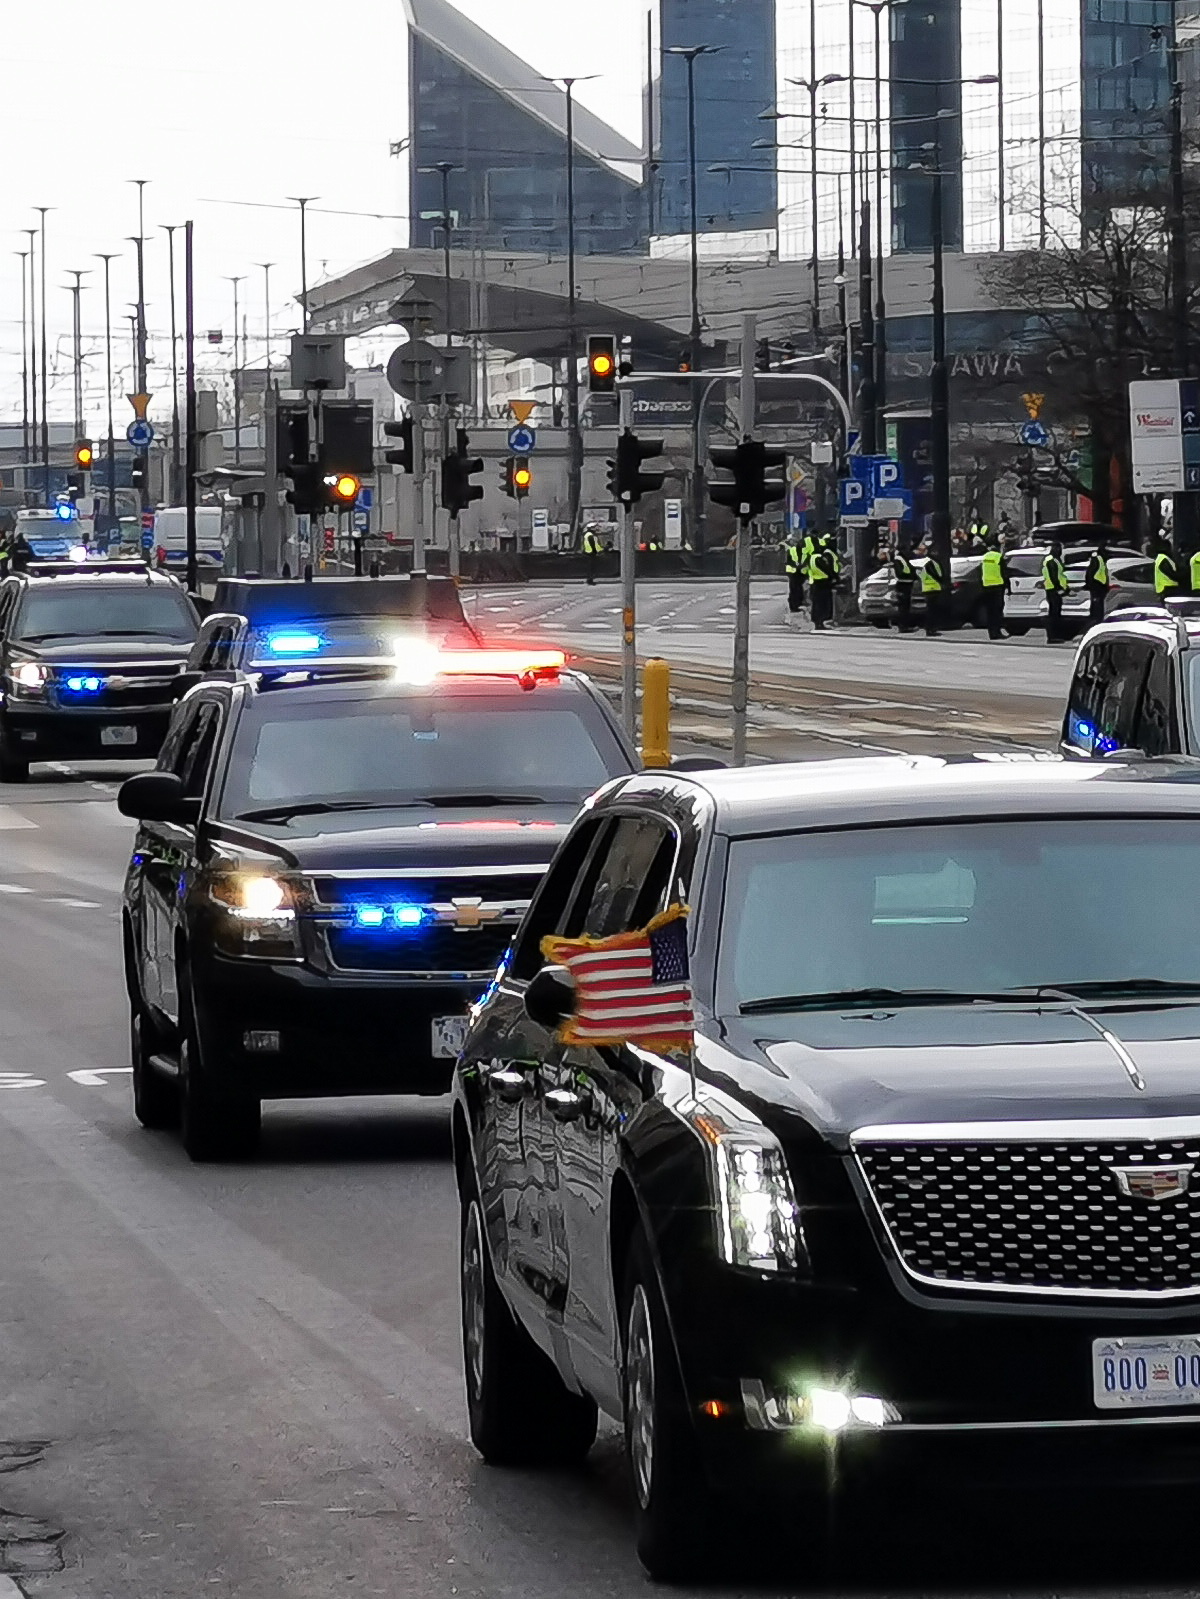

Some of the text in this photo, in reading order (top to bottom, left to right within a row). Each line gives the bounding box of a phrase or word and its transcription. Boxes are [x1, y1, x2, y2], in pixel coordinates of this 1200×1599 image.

[880, 464, 897, 487] P
[846, 482, 862, 505] P
[1104, 1357, 1147, 1392] 800
